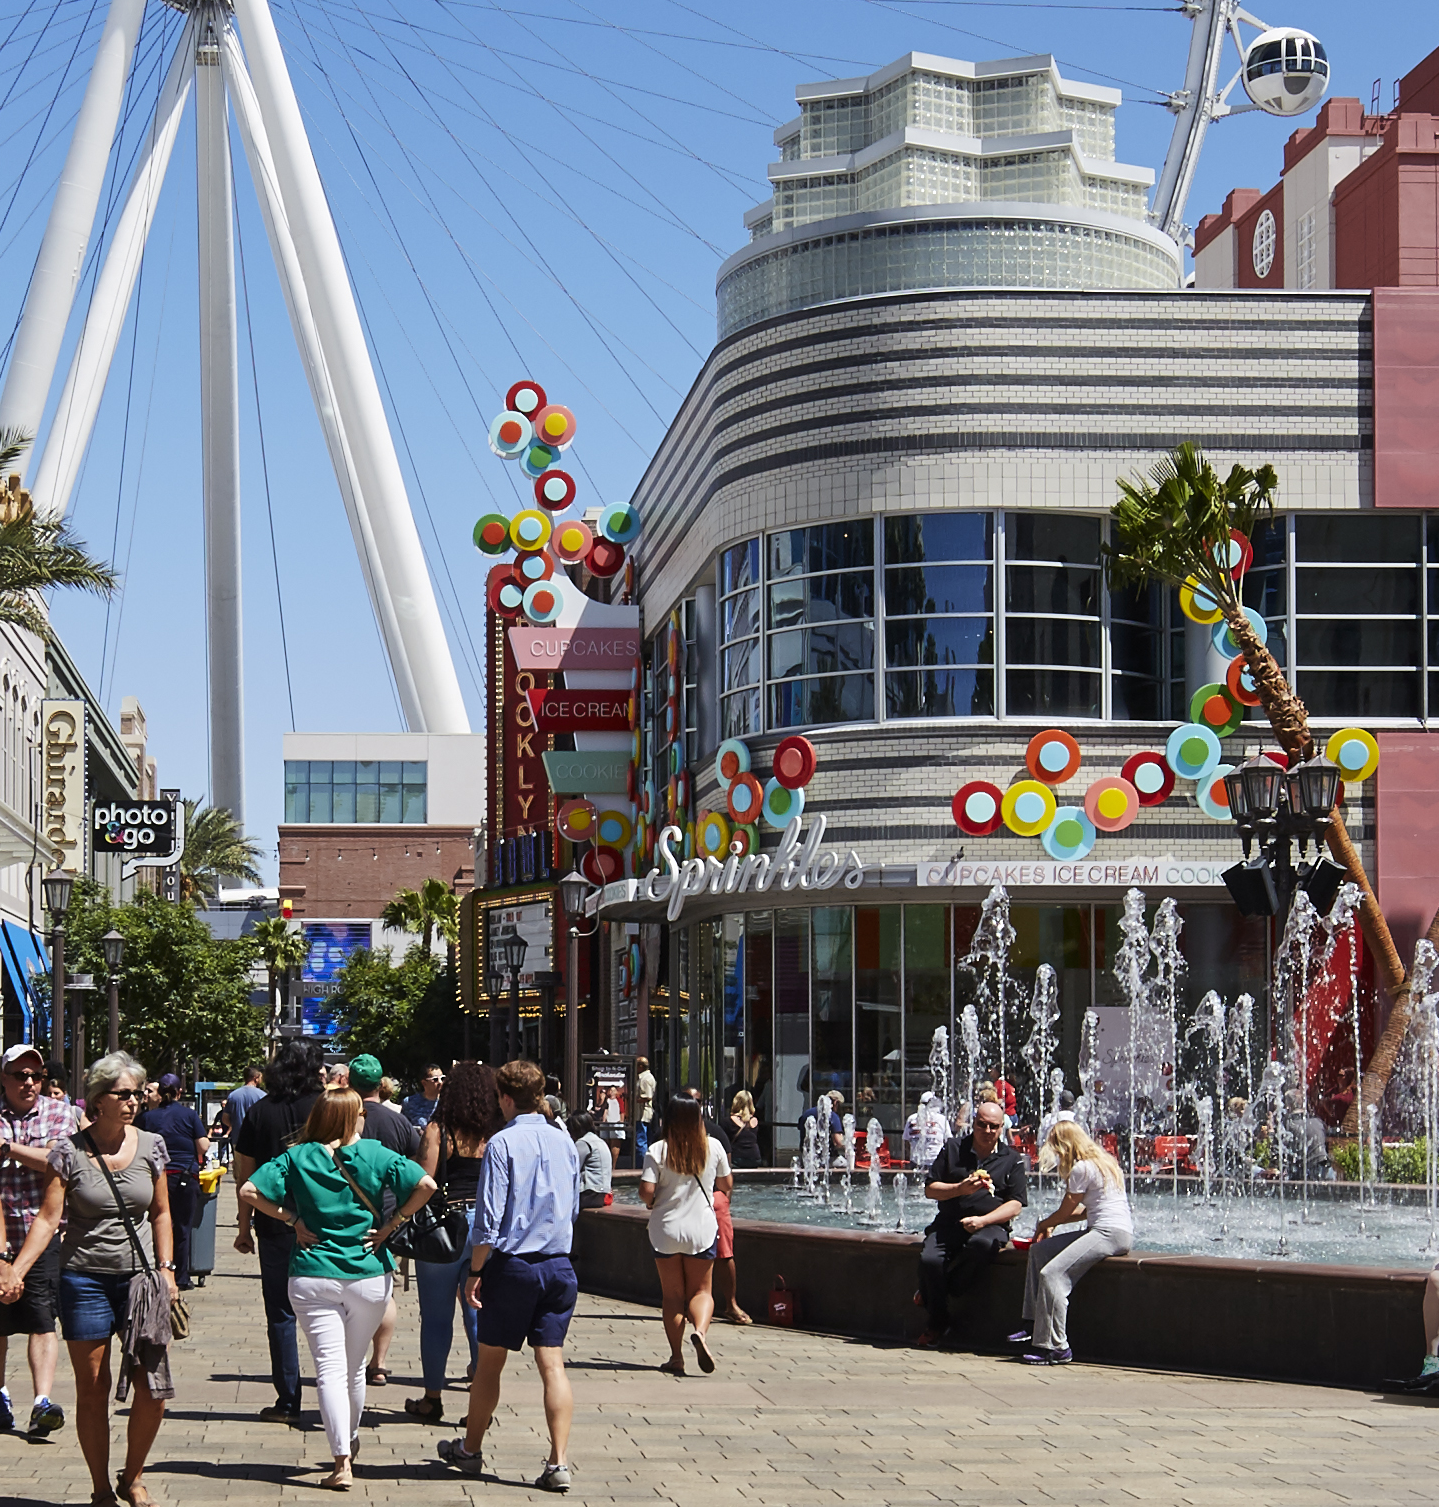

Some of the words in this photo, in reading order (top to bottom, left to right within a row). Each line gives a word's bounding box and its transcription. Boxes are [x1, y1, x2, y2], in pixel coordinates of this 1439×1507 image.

[530, 640, 637, 658] CUPCAKES
[541, 702, 570, 717] ICE
[94, 802, 169, 829] photo
[645, 814, 884, 921] Sprinkles
[927, 865, 1045, 884] CUPCAKES
[1052, 865, 1084, 883] ICE
[1088, 865, 1160, 883] CREAM
